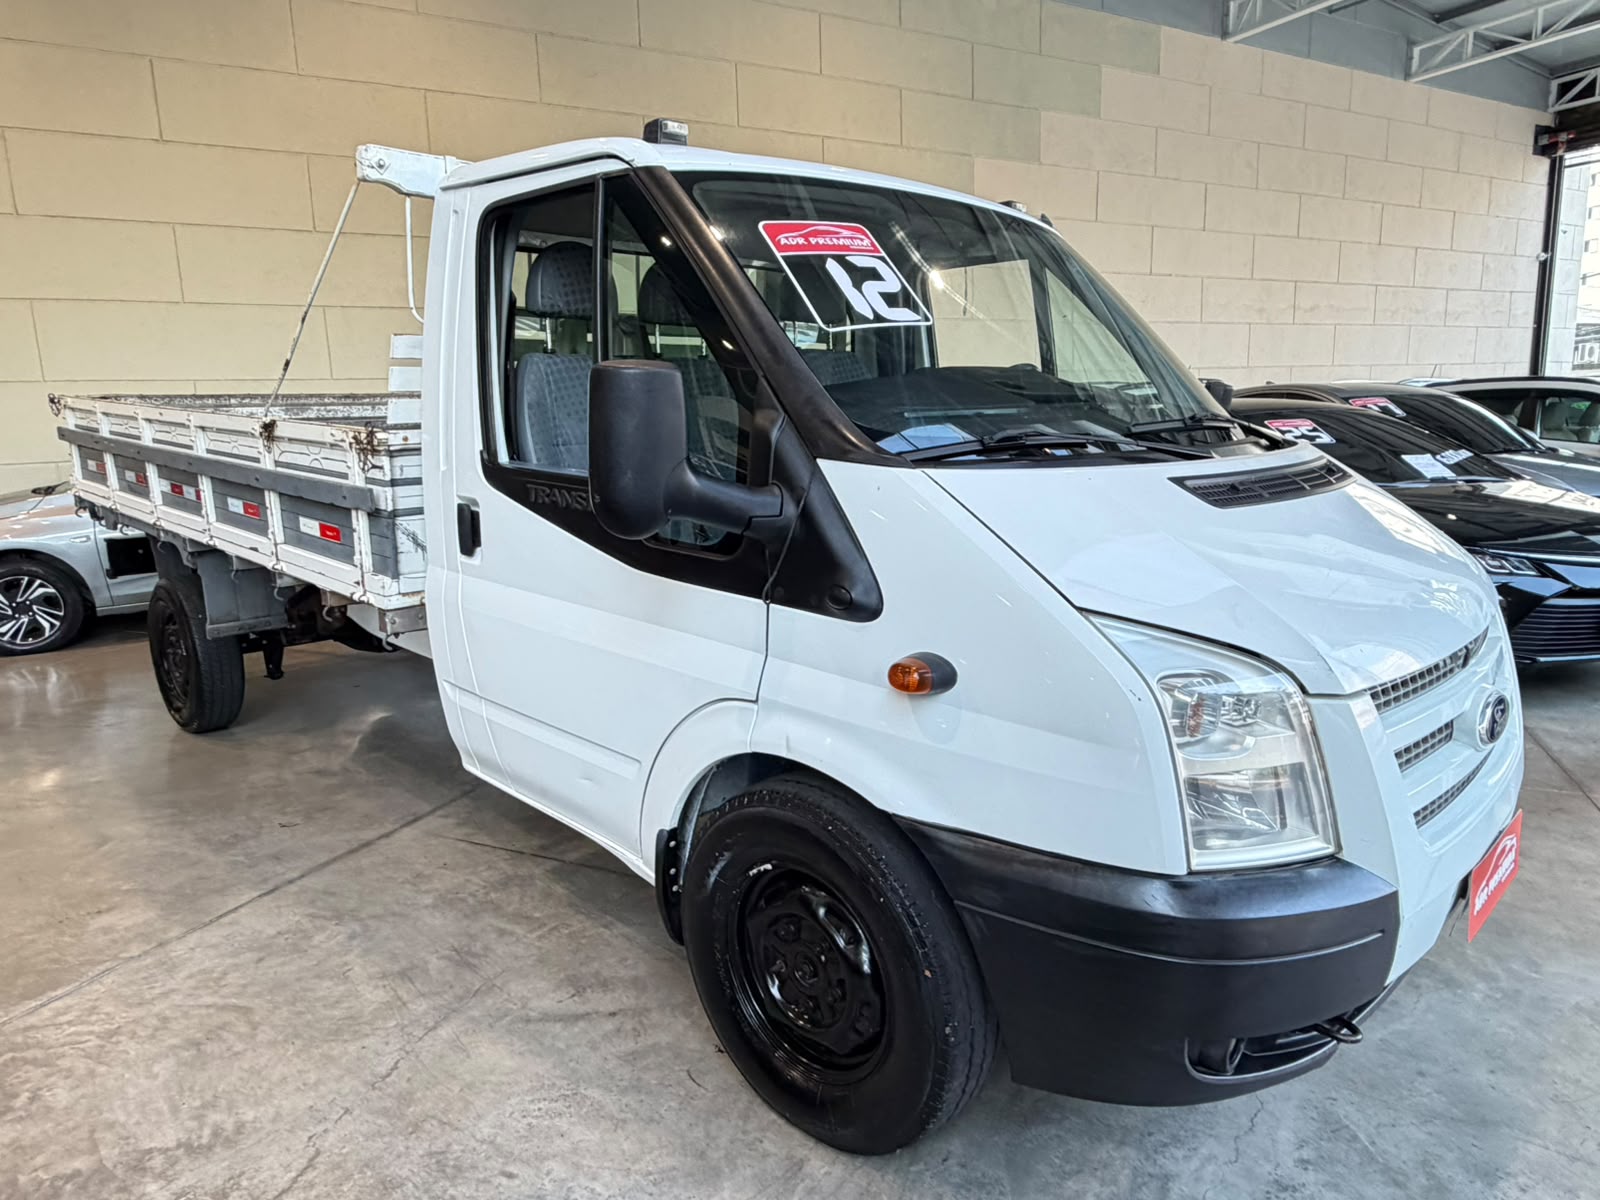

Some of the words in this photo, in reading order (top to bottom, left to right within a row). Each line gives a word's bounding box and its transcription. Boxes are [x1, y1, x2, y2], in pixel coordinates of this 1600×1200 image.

[780, 237, 808, 246] ADR
[808, 237, 872, 248] PREMIUM
[825, 255, 922, 321] 12
[526, 484, 592, 511] TRANS
